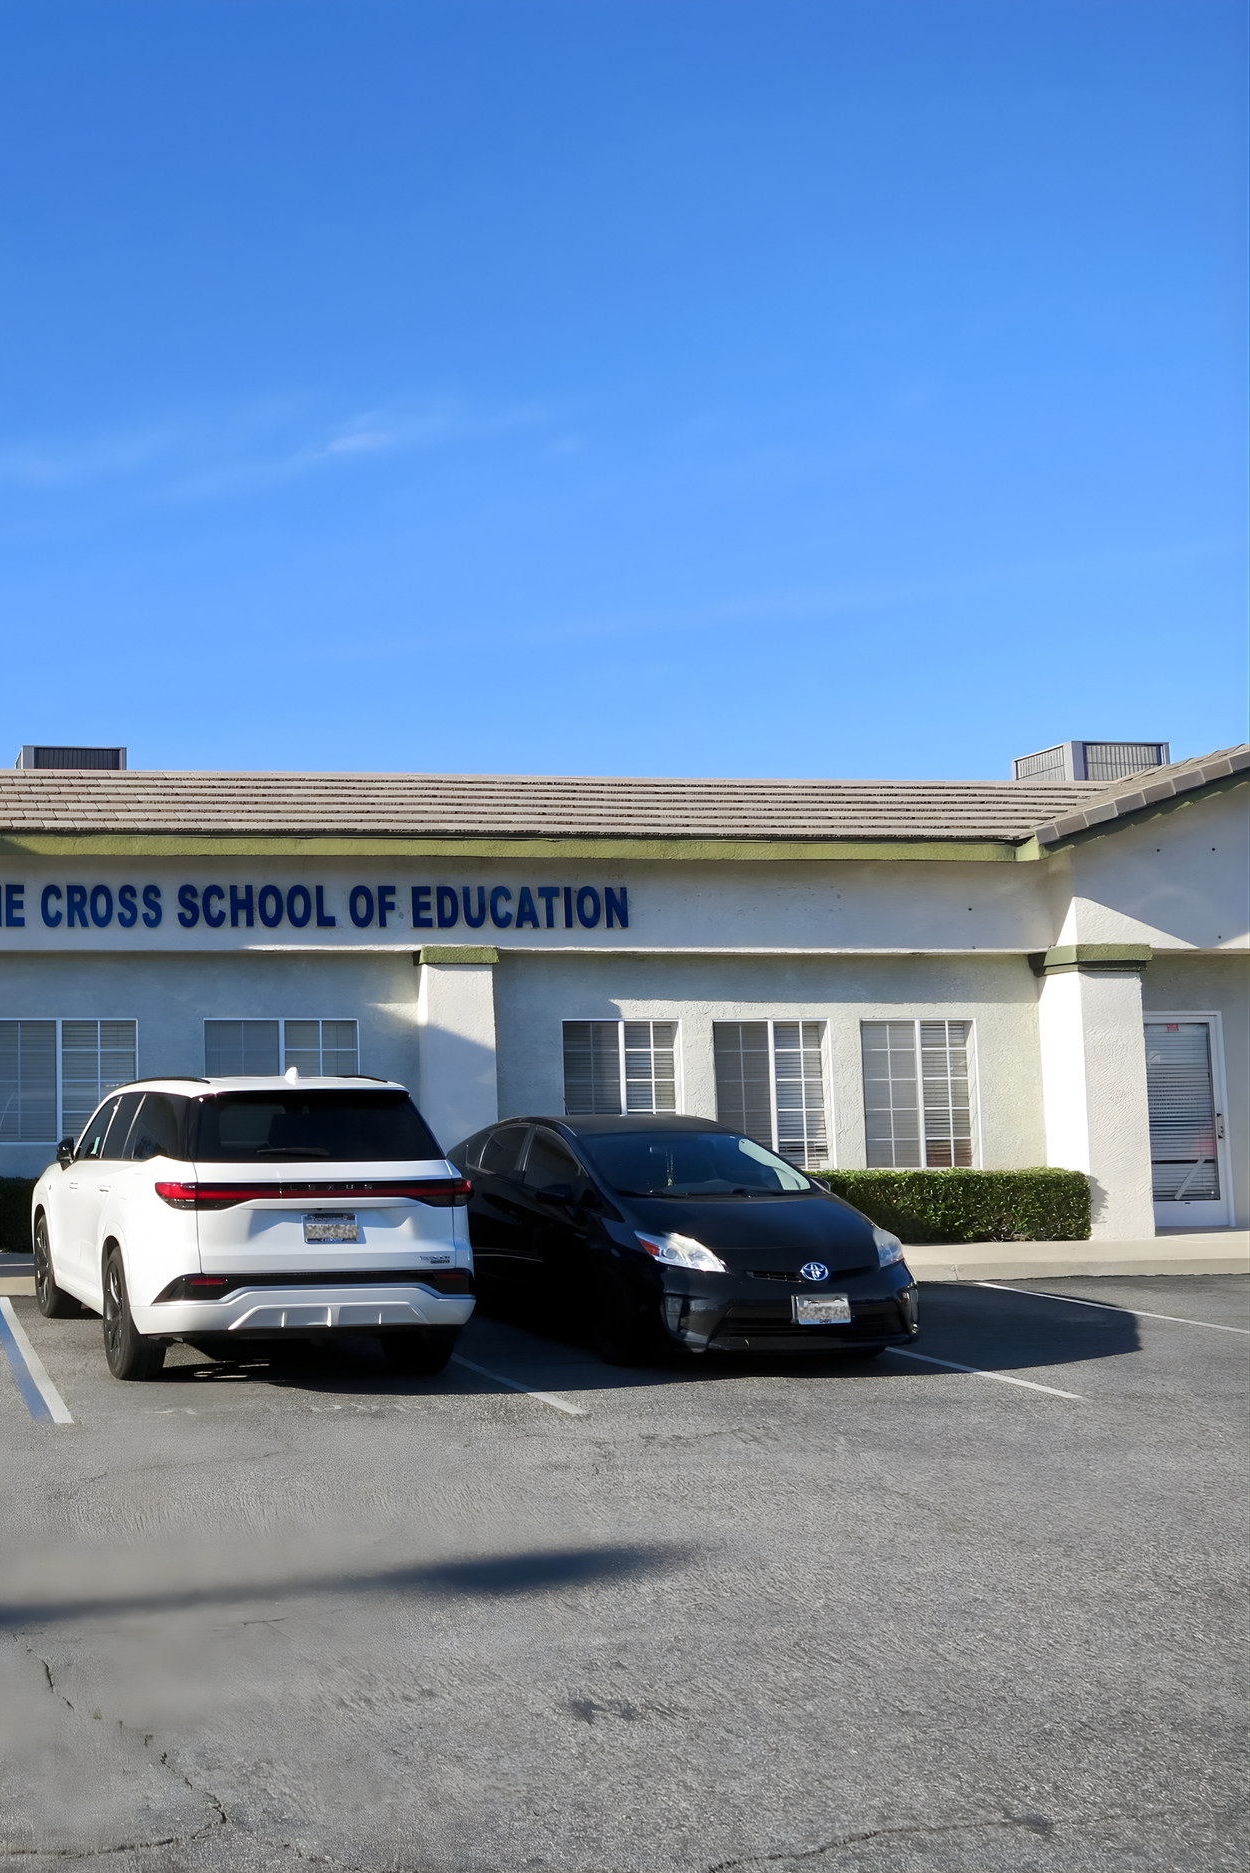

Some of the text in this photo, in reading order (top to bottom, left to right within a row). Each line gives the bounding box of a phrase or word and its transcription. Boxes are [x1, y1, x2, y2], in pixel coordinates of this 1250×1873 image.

[40, 884, 163, 929] CROSS
[177, 884, 337, 929] SCHOOL
[348, 884, 397, 929] OF
[410, 885, 630, 929] EDUCATION
